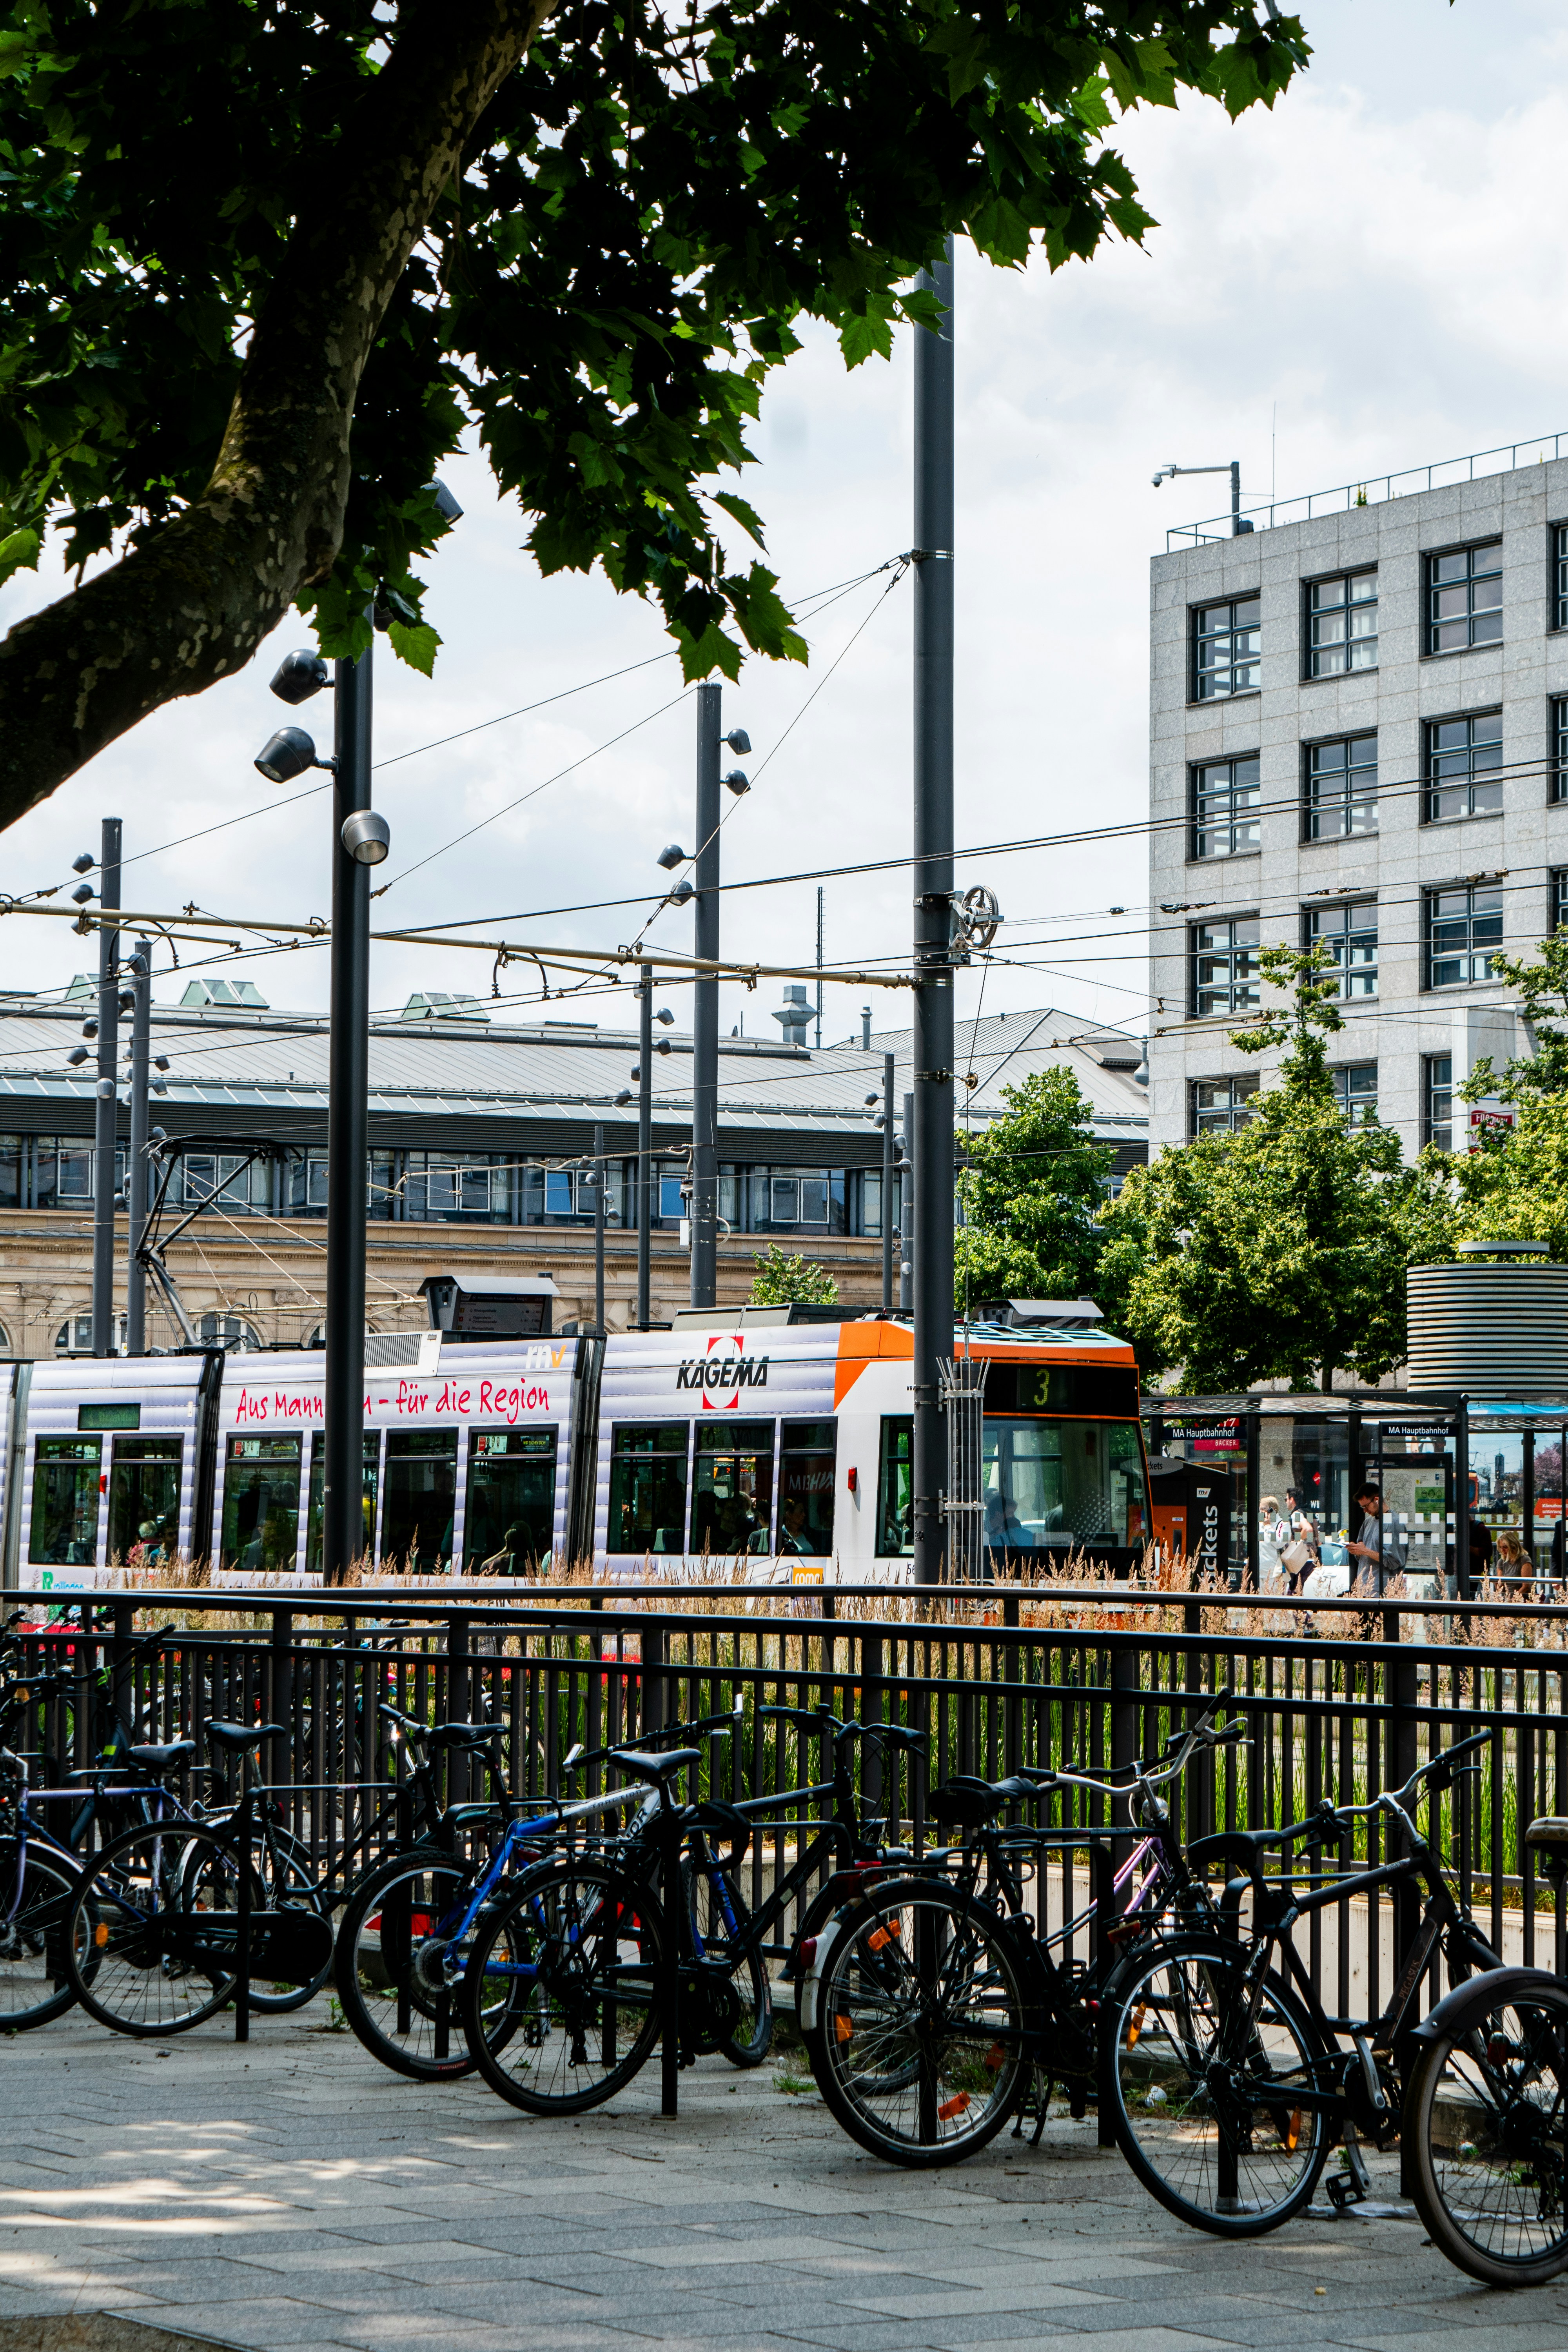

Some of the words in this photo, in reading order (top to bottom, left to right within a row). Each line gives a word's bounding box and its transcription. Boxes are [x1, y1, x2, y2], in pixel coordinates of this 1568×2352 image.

[526, 1345, 567, 1368] rnv
[676, 1356, 769, 1389] KAGEMA
[236, 1388, 268, 1423] Aus
[396, 1380, 428, 1414] für
[436, 1381, 470, 1413] die
[480, 1377, 549, 1424] Region
[1034, 1369, 1049, 1405] 3
[1173, 1428, 1185, 1437] MA
[1186, 1427, 1235, 1439] Hauptbahnhof
[1402, 1426, 1449, 1436] Hauptbahnhof
[592, 1789, 642, 1809] TRACTION
[1398, 1960, 1420, 2000] PEGASUS
